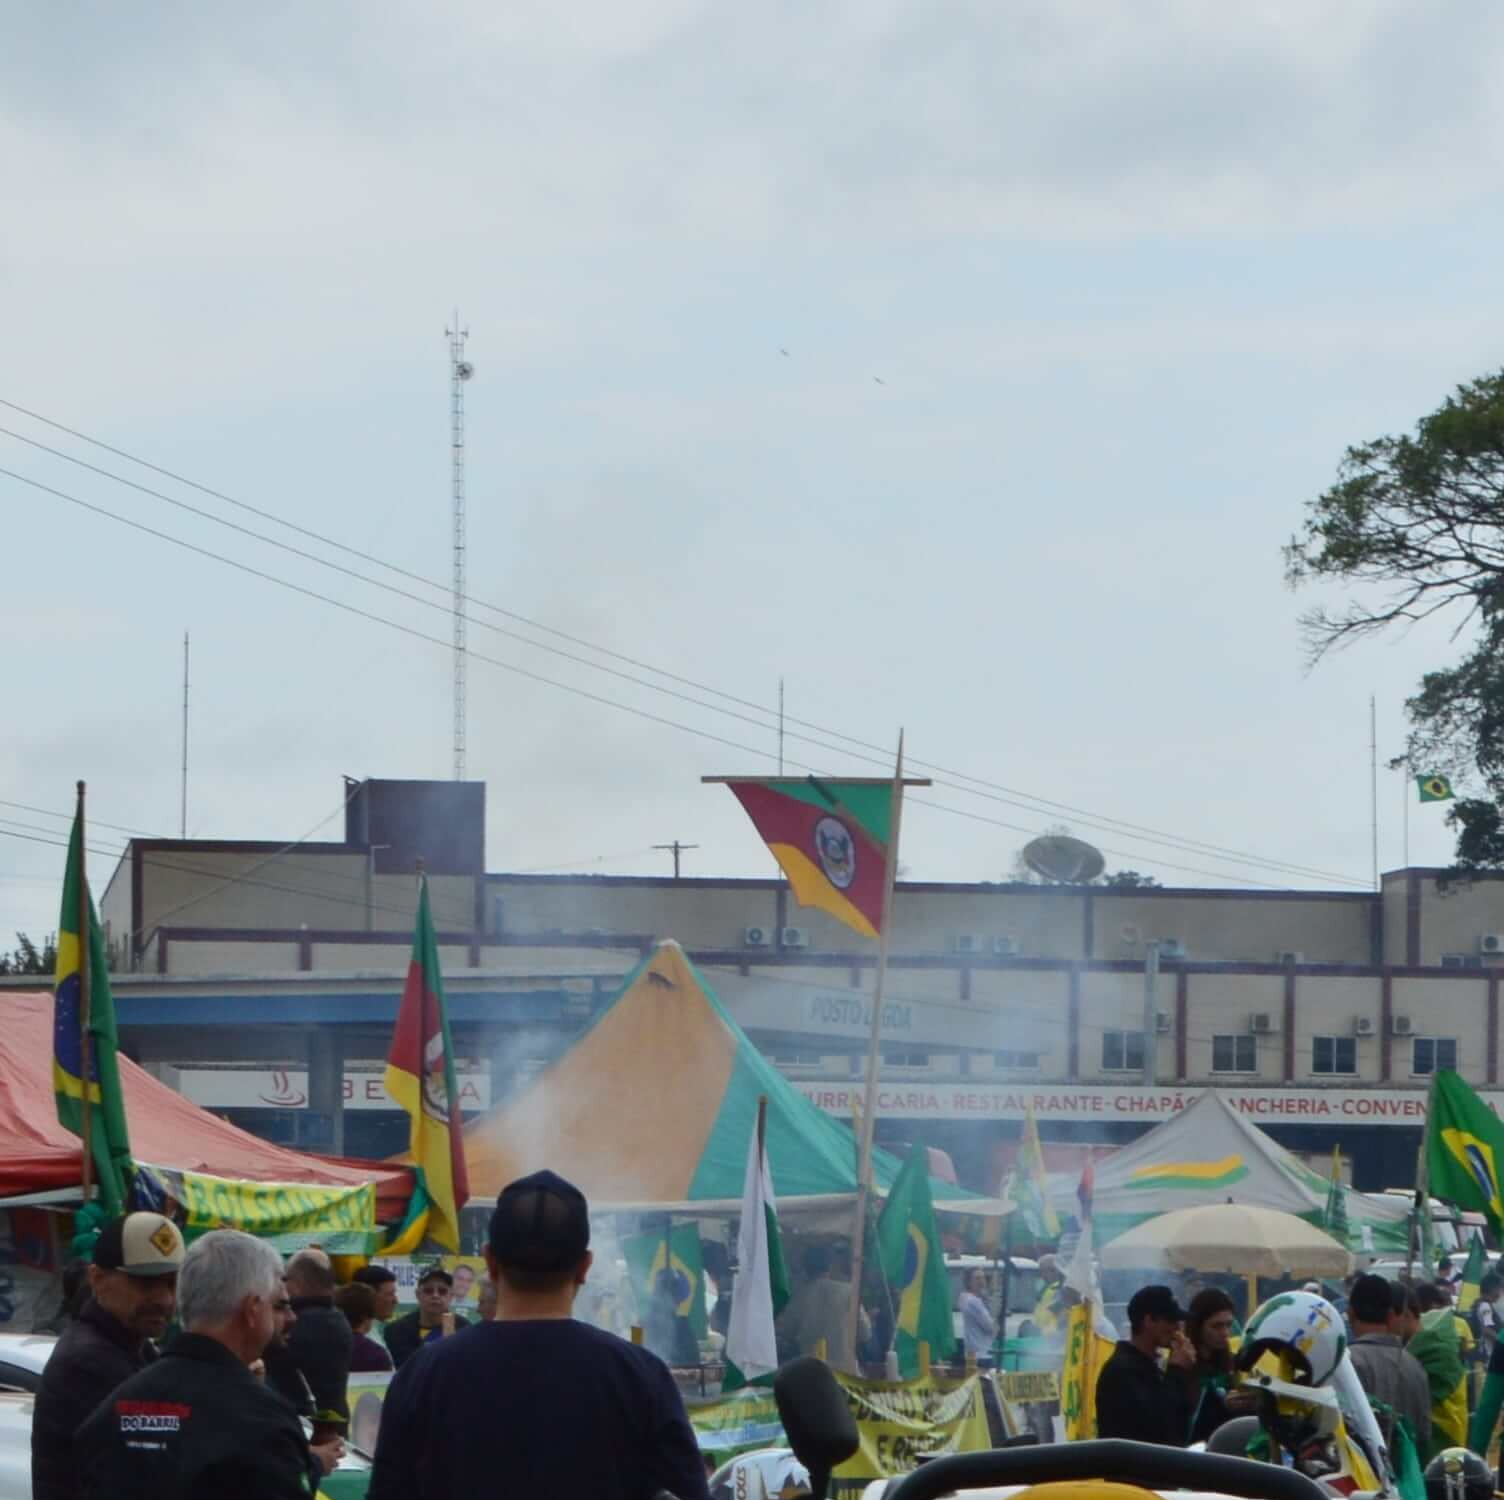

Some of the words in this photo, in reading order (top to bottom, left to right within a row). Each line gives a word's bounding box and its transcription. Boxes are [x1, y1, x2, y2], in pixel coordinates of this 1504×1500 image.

[808, 997, 861, 1024] POSTO
[863, 1004, 912, 1029] LGOA
[953, 1092, 1101, 1112] RESTAURANTE
